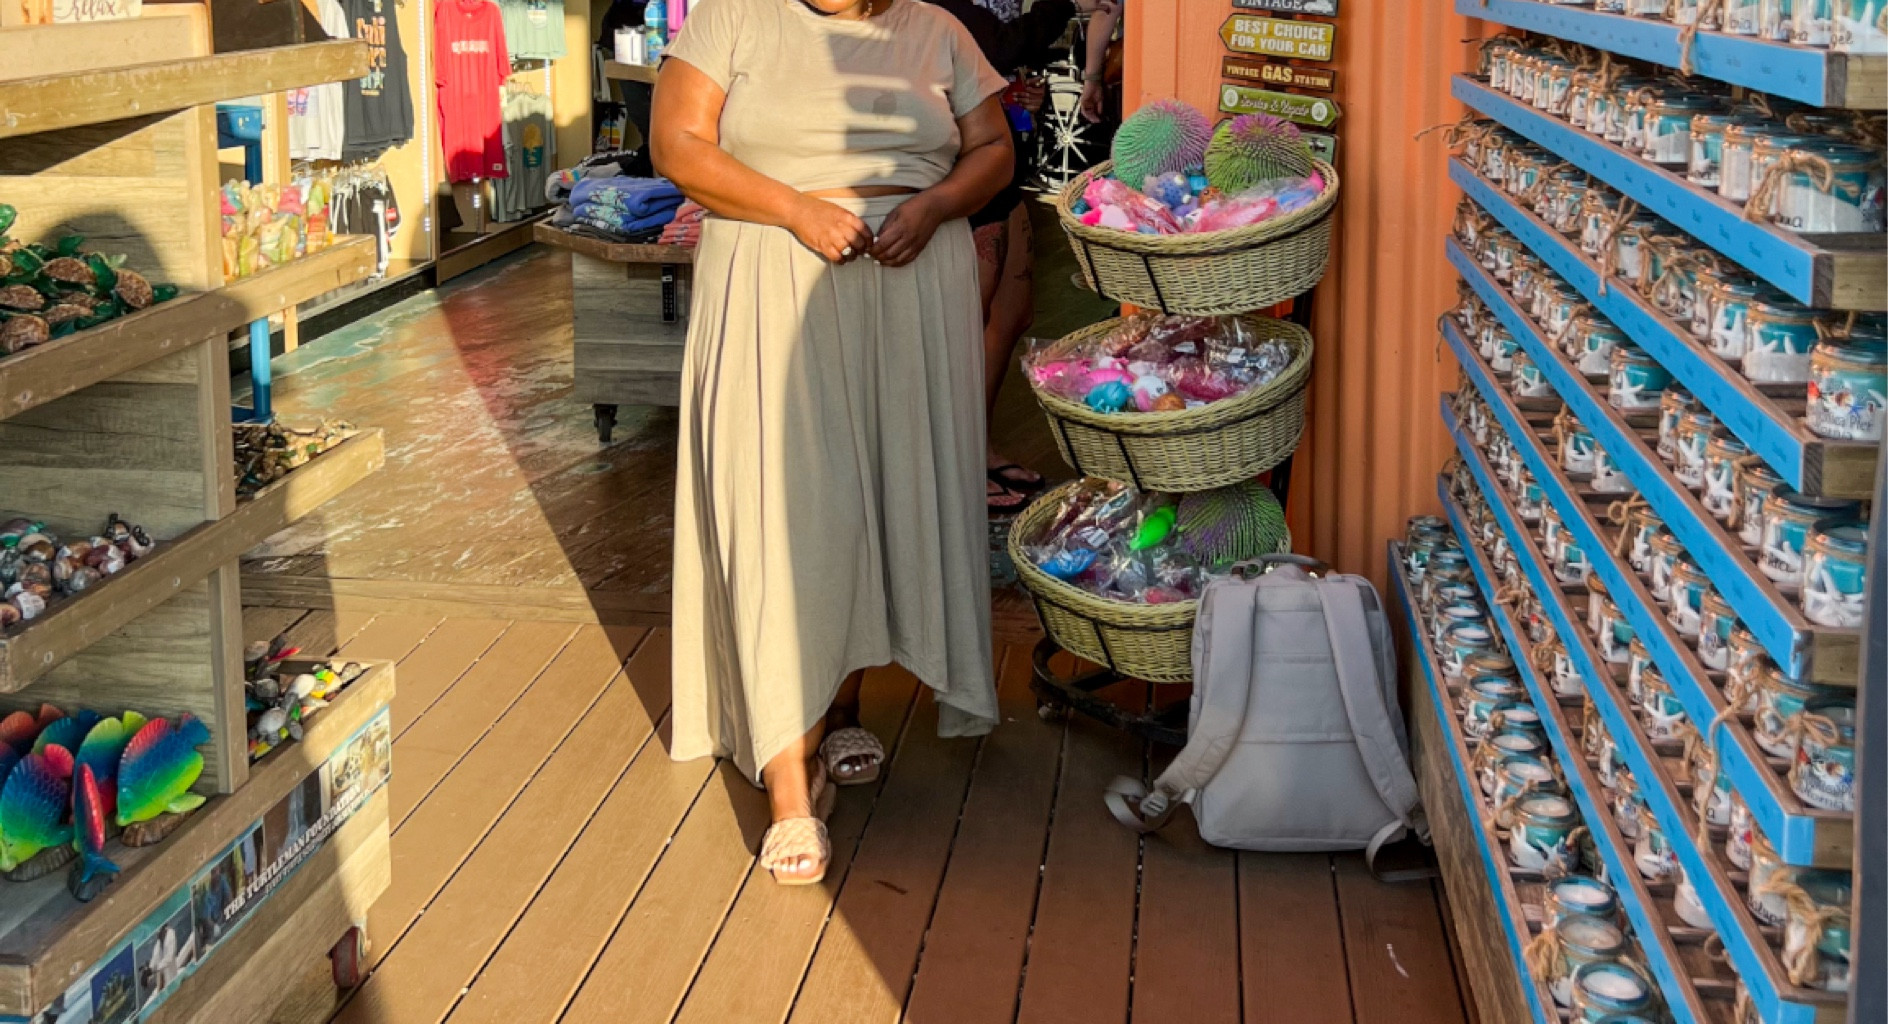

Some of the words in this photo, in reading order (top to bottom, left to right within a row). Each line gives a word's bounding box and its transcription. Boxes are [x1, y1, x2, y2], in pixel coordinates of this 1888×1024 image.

[1234, 19, 1269, 35] BEST
[1273, 22, 1327, 42] CHOICE
[1231, 34, 1256, 48] FOR
[1260, 37, 1295, 53] YOUR
[1298, 41, 1327, 57] CAR
[1226, 64, 1260, 78] VINTAGE
[1262, 64, 1293, 83] GAS
[1294, 74, 1331, 87] STATION
[223, 893, 246, 920] THE
